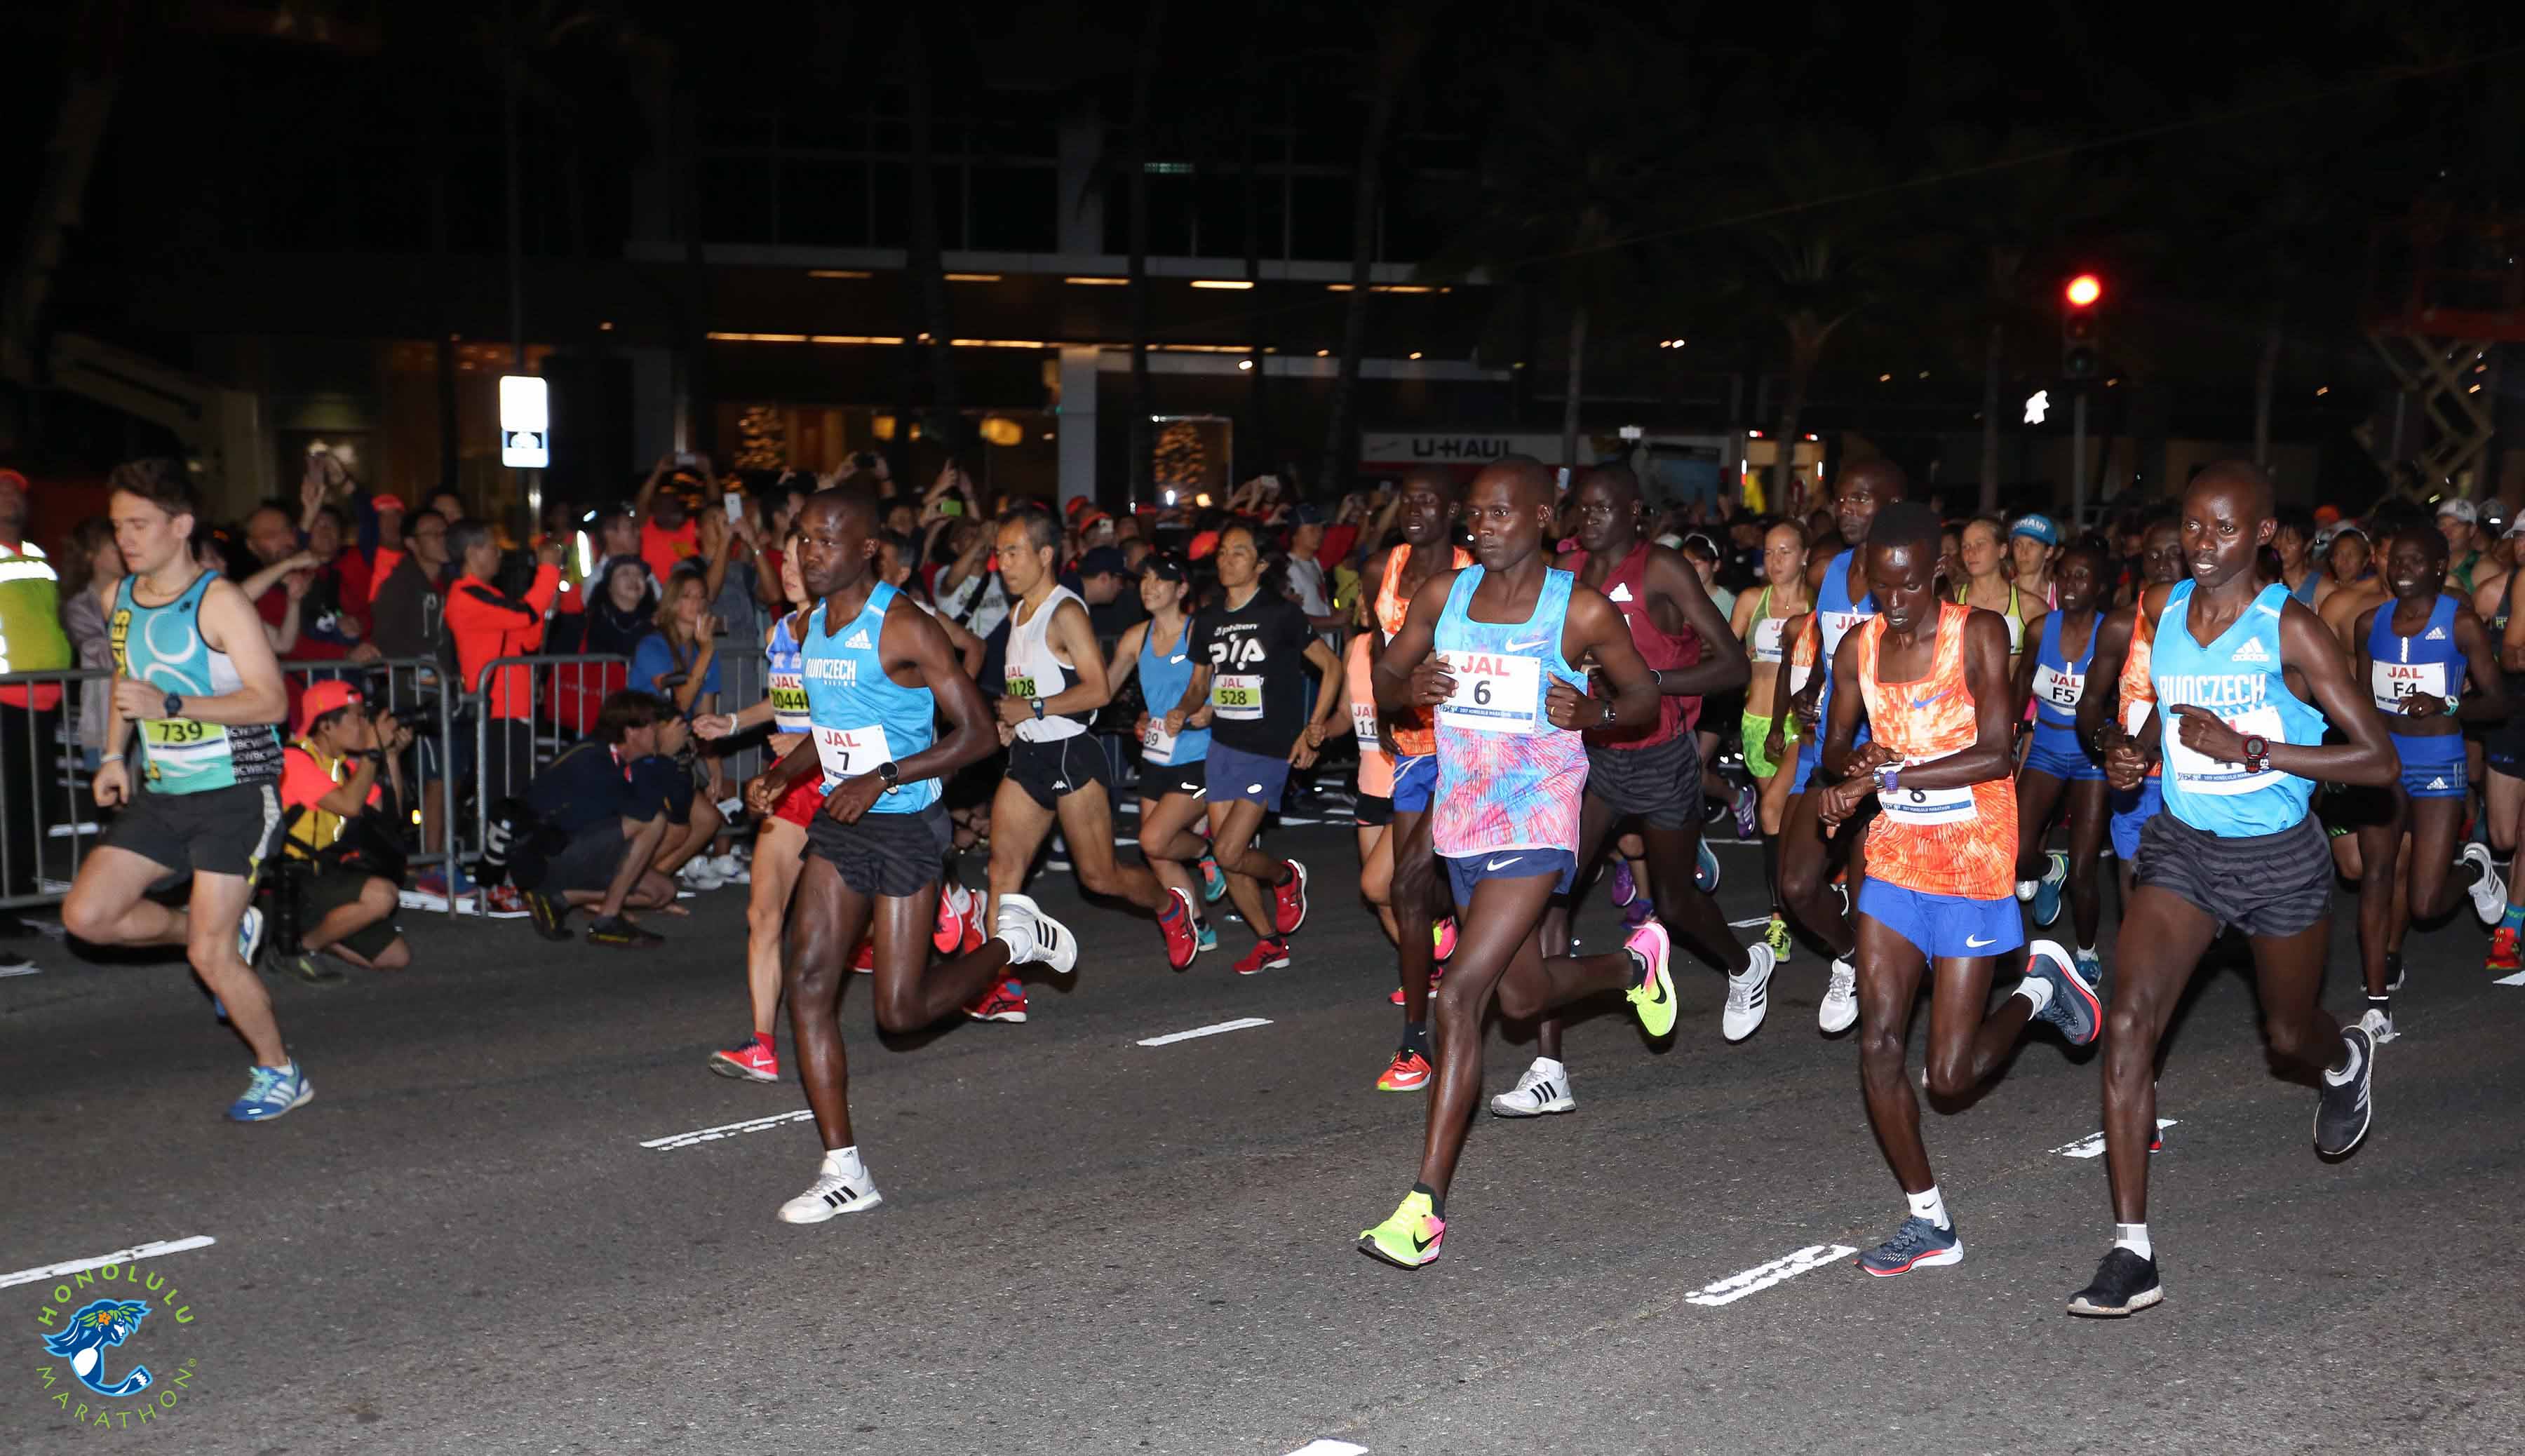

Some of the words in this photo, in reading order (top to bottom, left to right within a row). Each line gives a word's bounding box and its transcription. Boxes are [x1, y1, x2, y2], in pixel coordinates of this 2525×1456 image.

[804, 657, 856, 681] RUNCZECH
[1460, 655, 1511, 677] JAL
[2387, 666, 2424, 679] JAL
[774, 676, 799, 688] JAL
[1222, 677, 1245, 688] JAL
[2049, 673, 2082, 688] JAL
[1220, 689, 1247, 706] 528
[1474, 680, 1492, 705] 6
[2052, 687, 2075, 703] F5
[2158, 673, 2266, 707] RUNCZECH
[2393, 682, 2418, 697] F4
[1354, 706, 1375, 718] JA
[159, 720, 203, 742] 739
[1150, 720, 1164, 732] AL
[824, 730, 861, 748] JAL
[837, 751, 850, 771] 7
